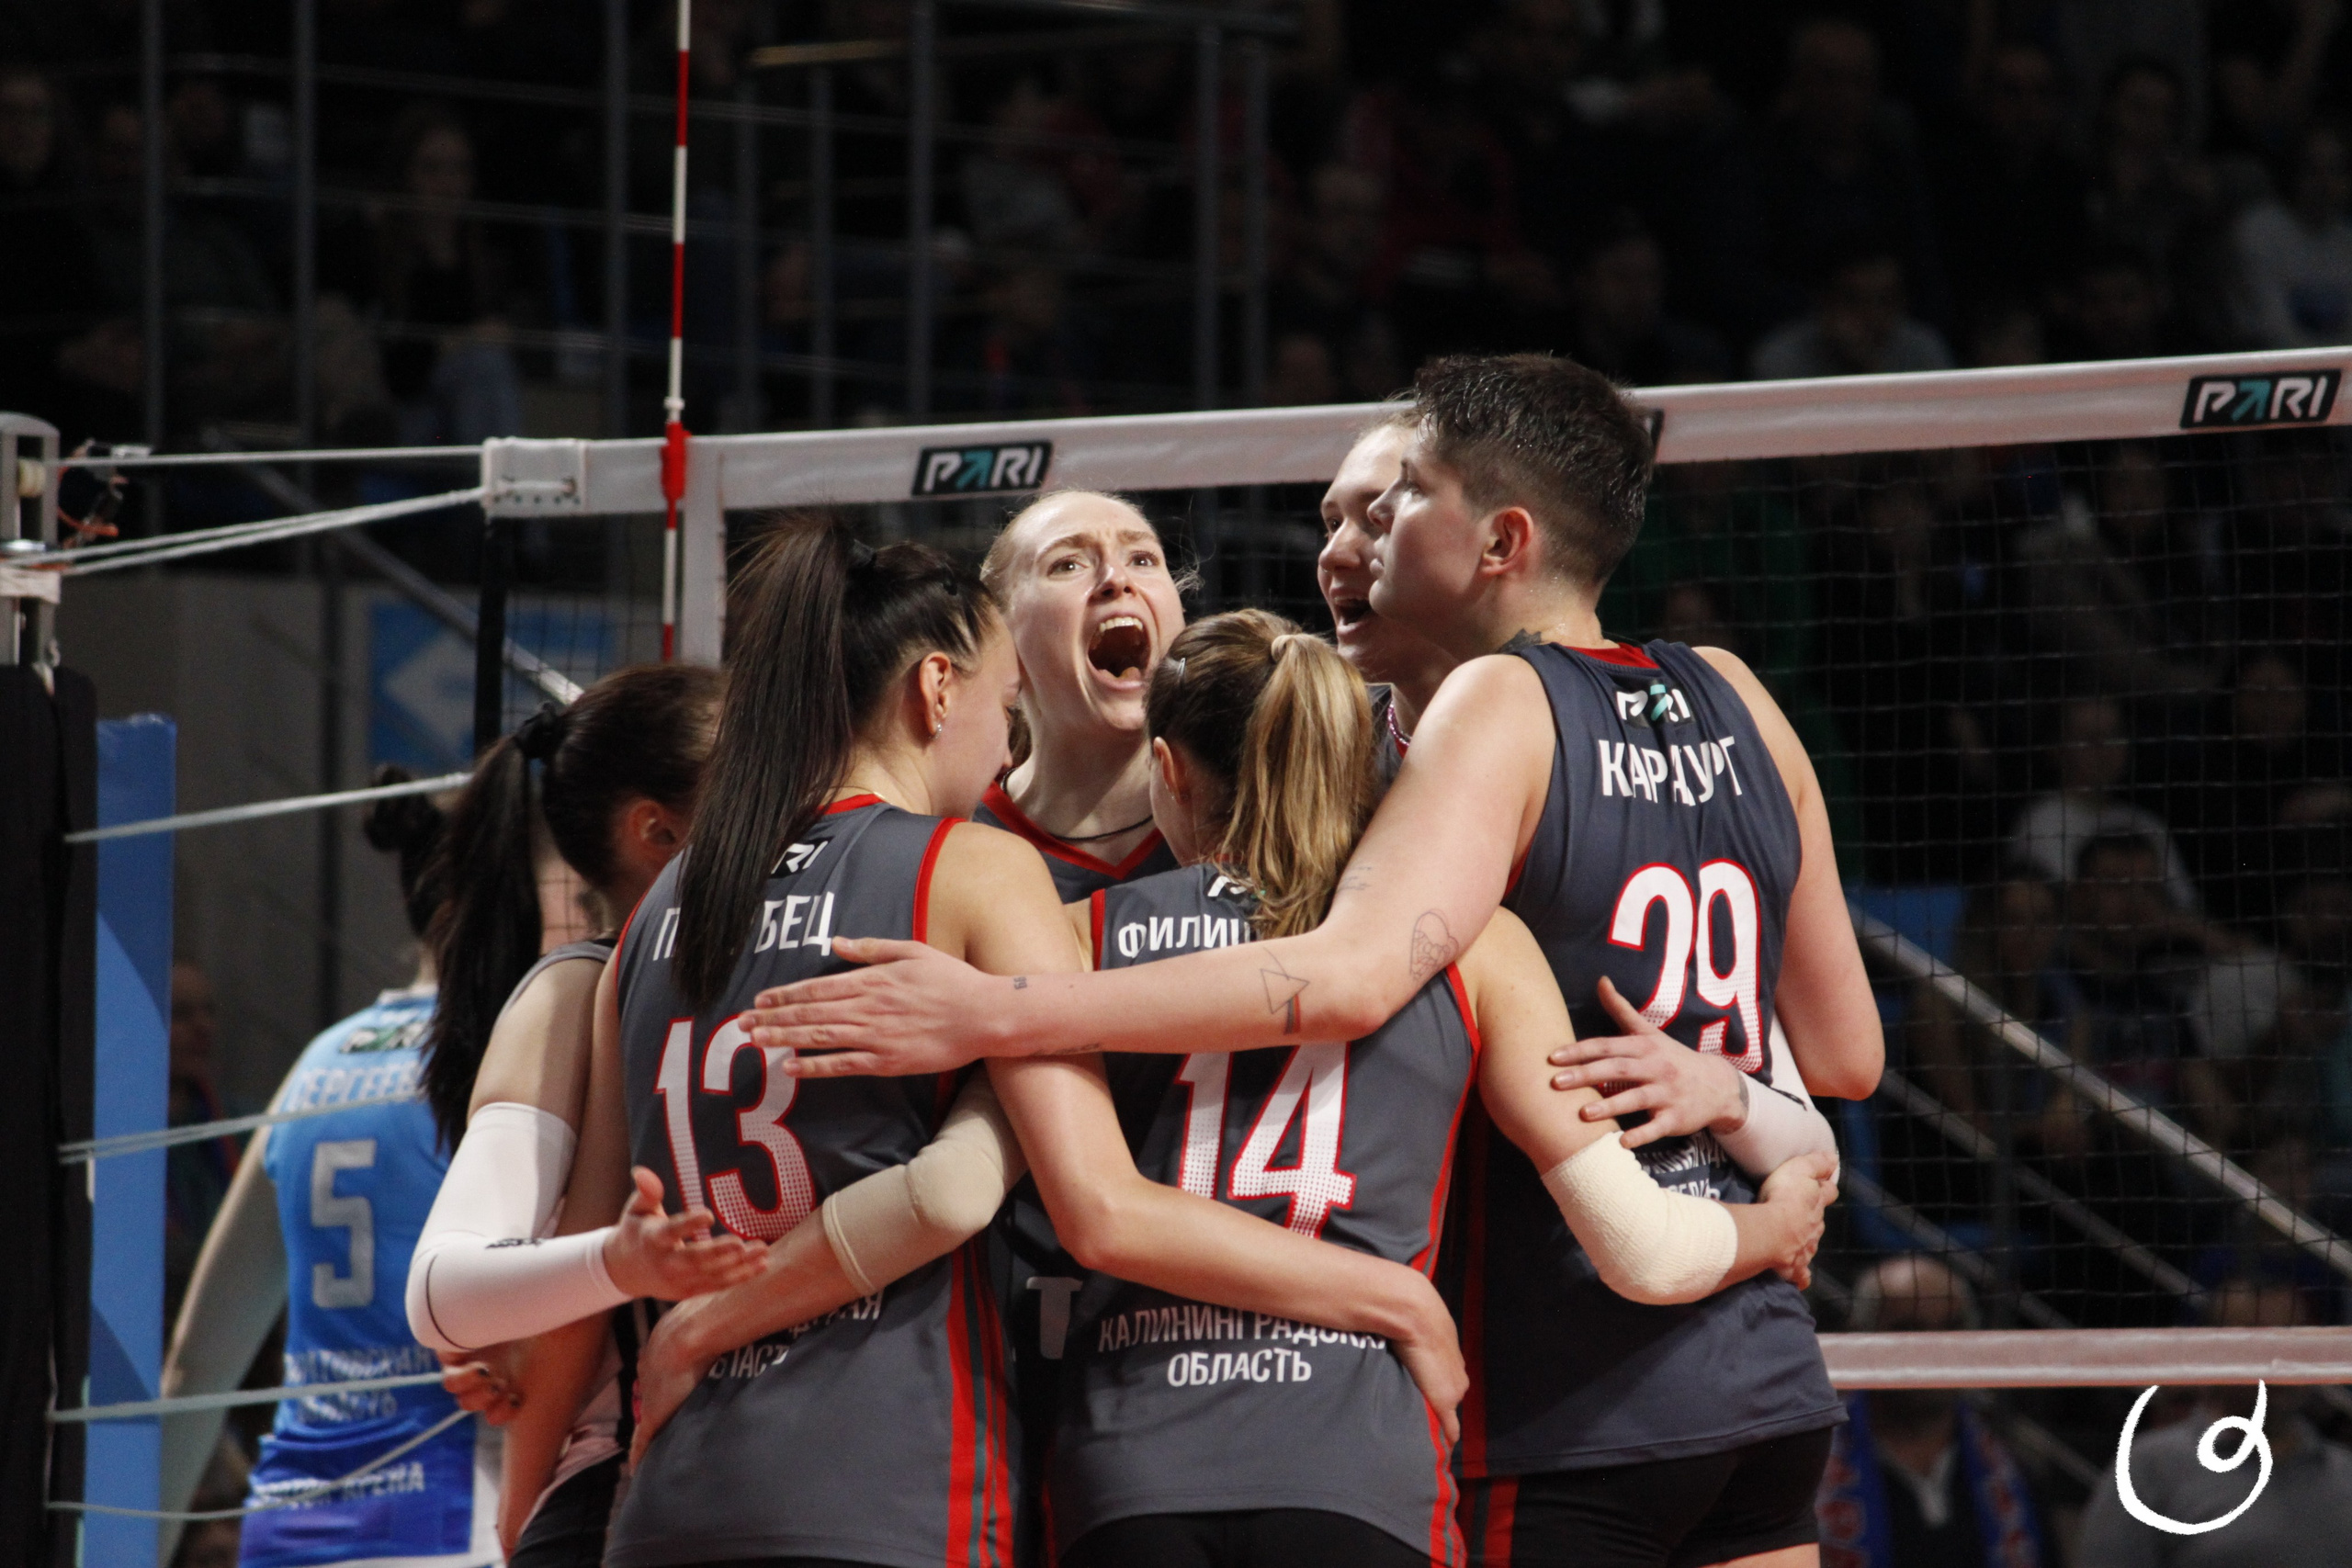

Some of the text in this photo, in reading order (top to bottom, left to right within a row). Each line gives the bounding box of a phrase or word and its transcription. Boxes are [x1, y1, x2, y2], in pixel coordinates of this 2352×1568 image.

[922, 446, 1044, 492] PARI
[2193, 375, 2328, 423] PARI
[1606, 856, 1764, 1098] 29
[653, 1014, 817, 1246] 13
[1173, 1041, 1357, 1240] 14
[311, 1138, 377, 1309] 5
[1167, 1348, 1312, 1387] ОБЛАСТЬ
